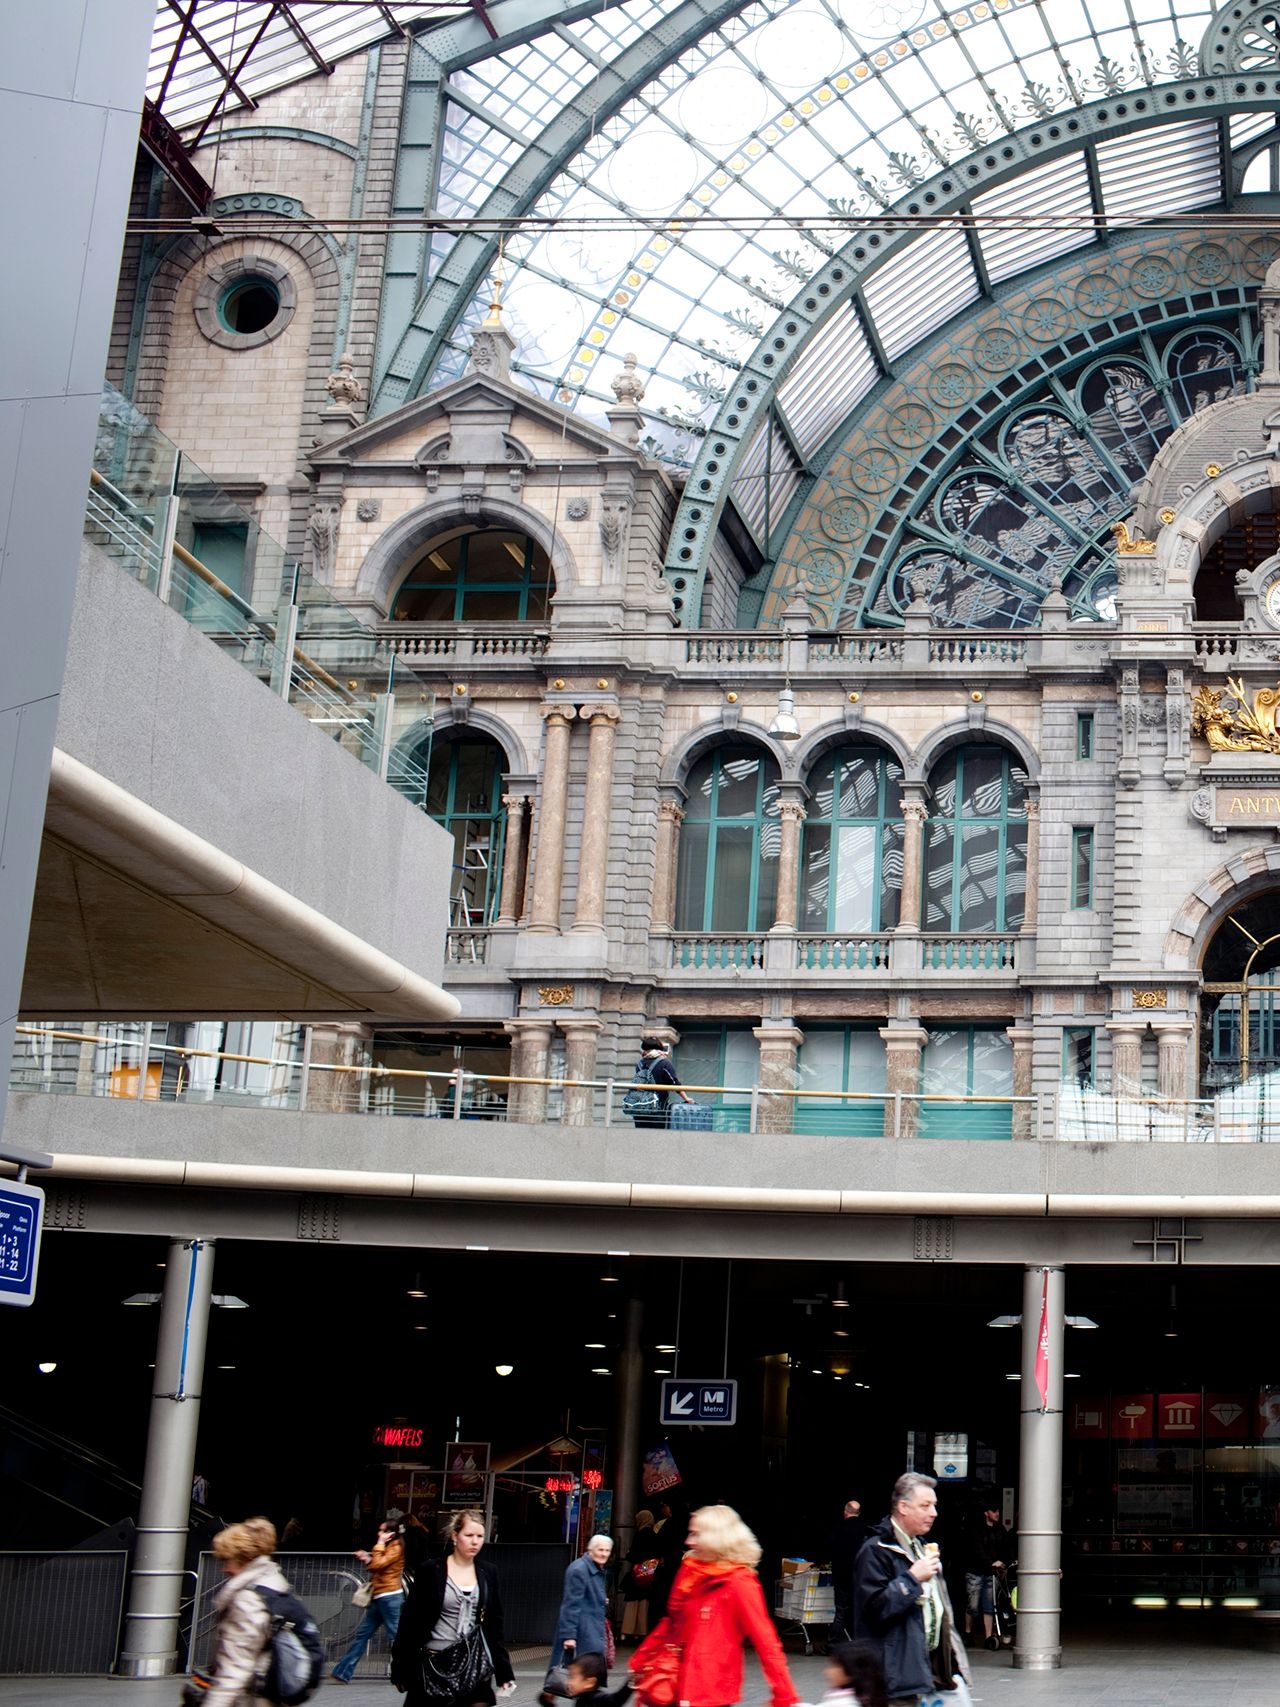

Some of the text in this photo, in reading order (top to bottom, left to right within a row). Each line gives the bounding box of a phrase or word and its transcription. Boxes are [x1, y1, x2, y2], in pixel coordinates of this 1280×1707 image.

[12, 1235, 18, 1246] 3
[384, 1427, 424, 1447] WAFELS
[647, 1474, 679, 1493] SOFTIJS
